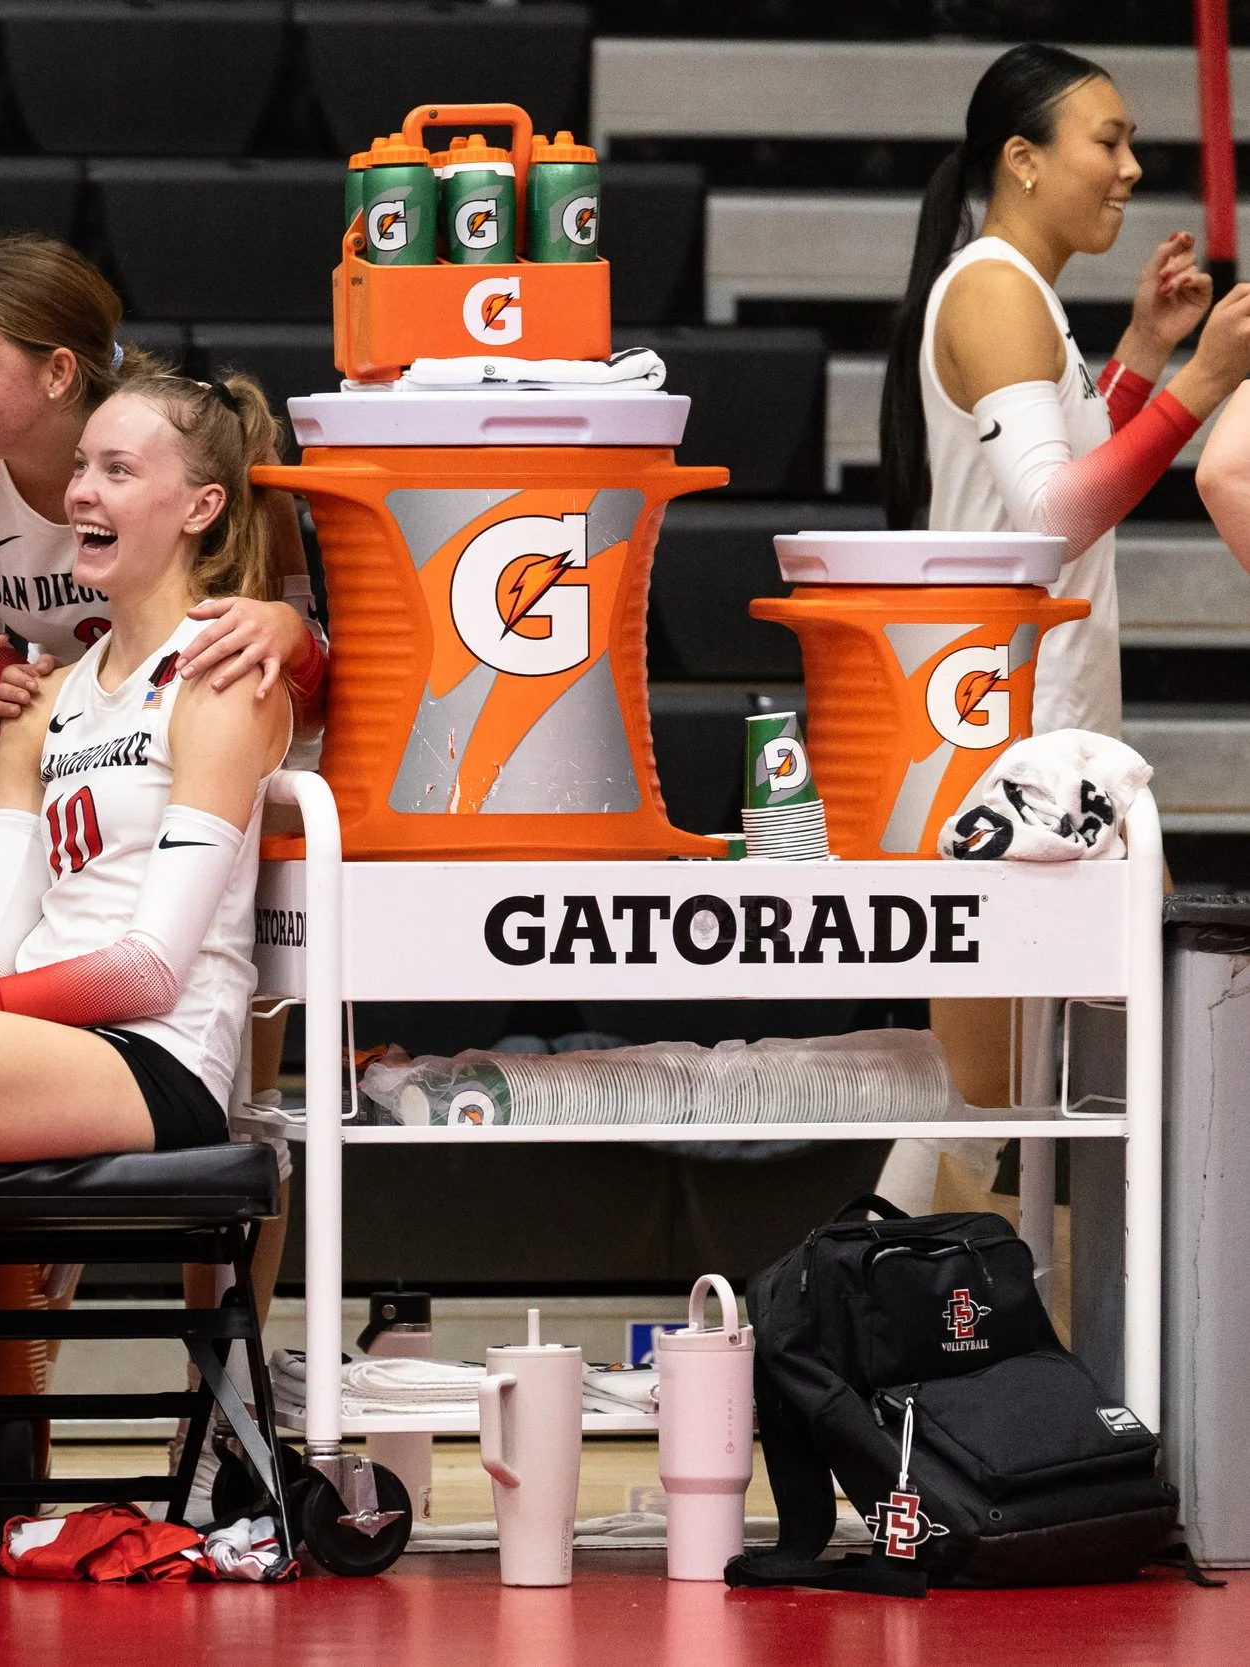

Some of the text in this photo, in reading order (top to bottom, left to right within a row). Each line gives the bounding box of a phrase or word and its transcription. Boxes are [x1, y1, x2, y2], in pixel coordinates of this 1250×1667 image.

[368, 200, 408, 251] G
[454, 198, 498, 250] G
[562, 196, 597, 246] G
[462, 276, 522, 345] G
[450, 513, 590, 677] G
[925, 644, 1010, 750] G
[763, 736, 807, 792] G
[46, 785, 103, 880] 10
[255, 908, 306, 947] ATORAD
[484, 894, 980, 966] GATORADE
[941, 1339, 989, 1352] VOLLEYBALL
